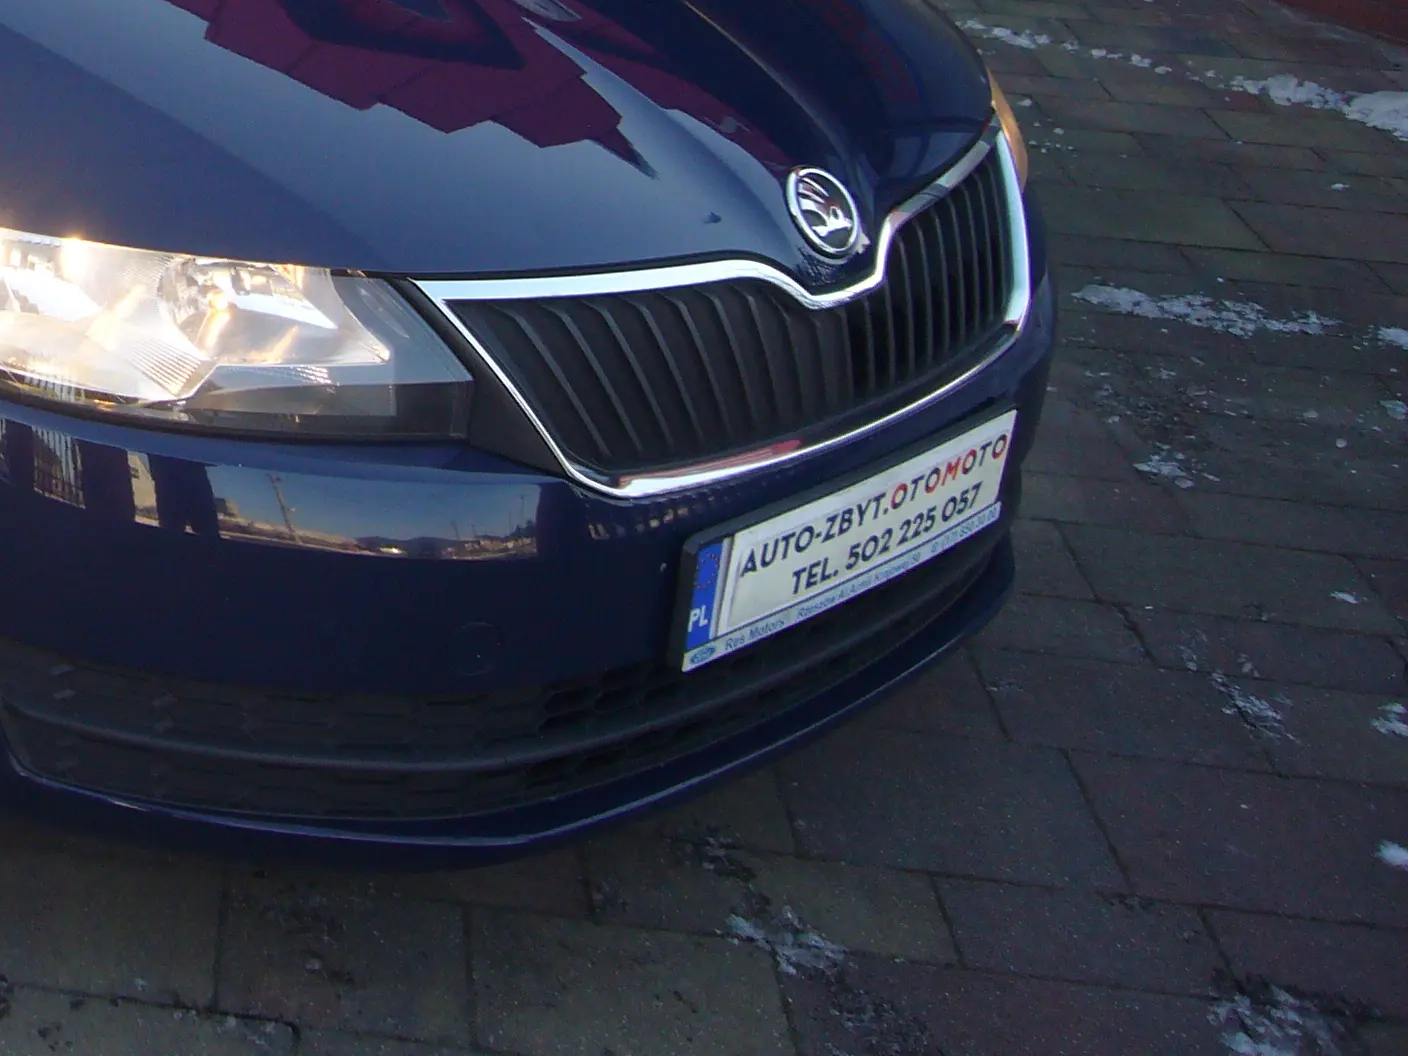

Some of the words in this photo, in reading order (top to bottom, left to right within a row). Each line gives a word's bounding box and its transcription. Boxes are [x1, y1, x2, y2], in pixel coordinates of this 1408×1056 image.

[740, 433, 1008, 578] AUTO-ZBYT.OTOMOTO
[792, 556, 839, 595] TEL.
[845, 527, 893, 571] 502
[897, 505, 938, 547] 225
[941, 481, 983, 523] 057
[688, 605, 709, 633] PL
